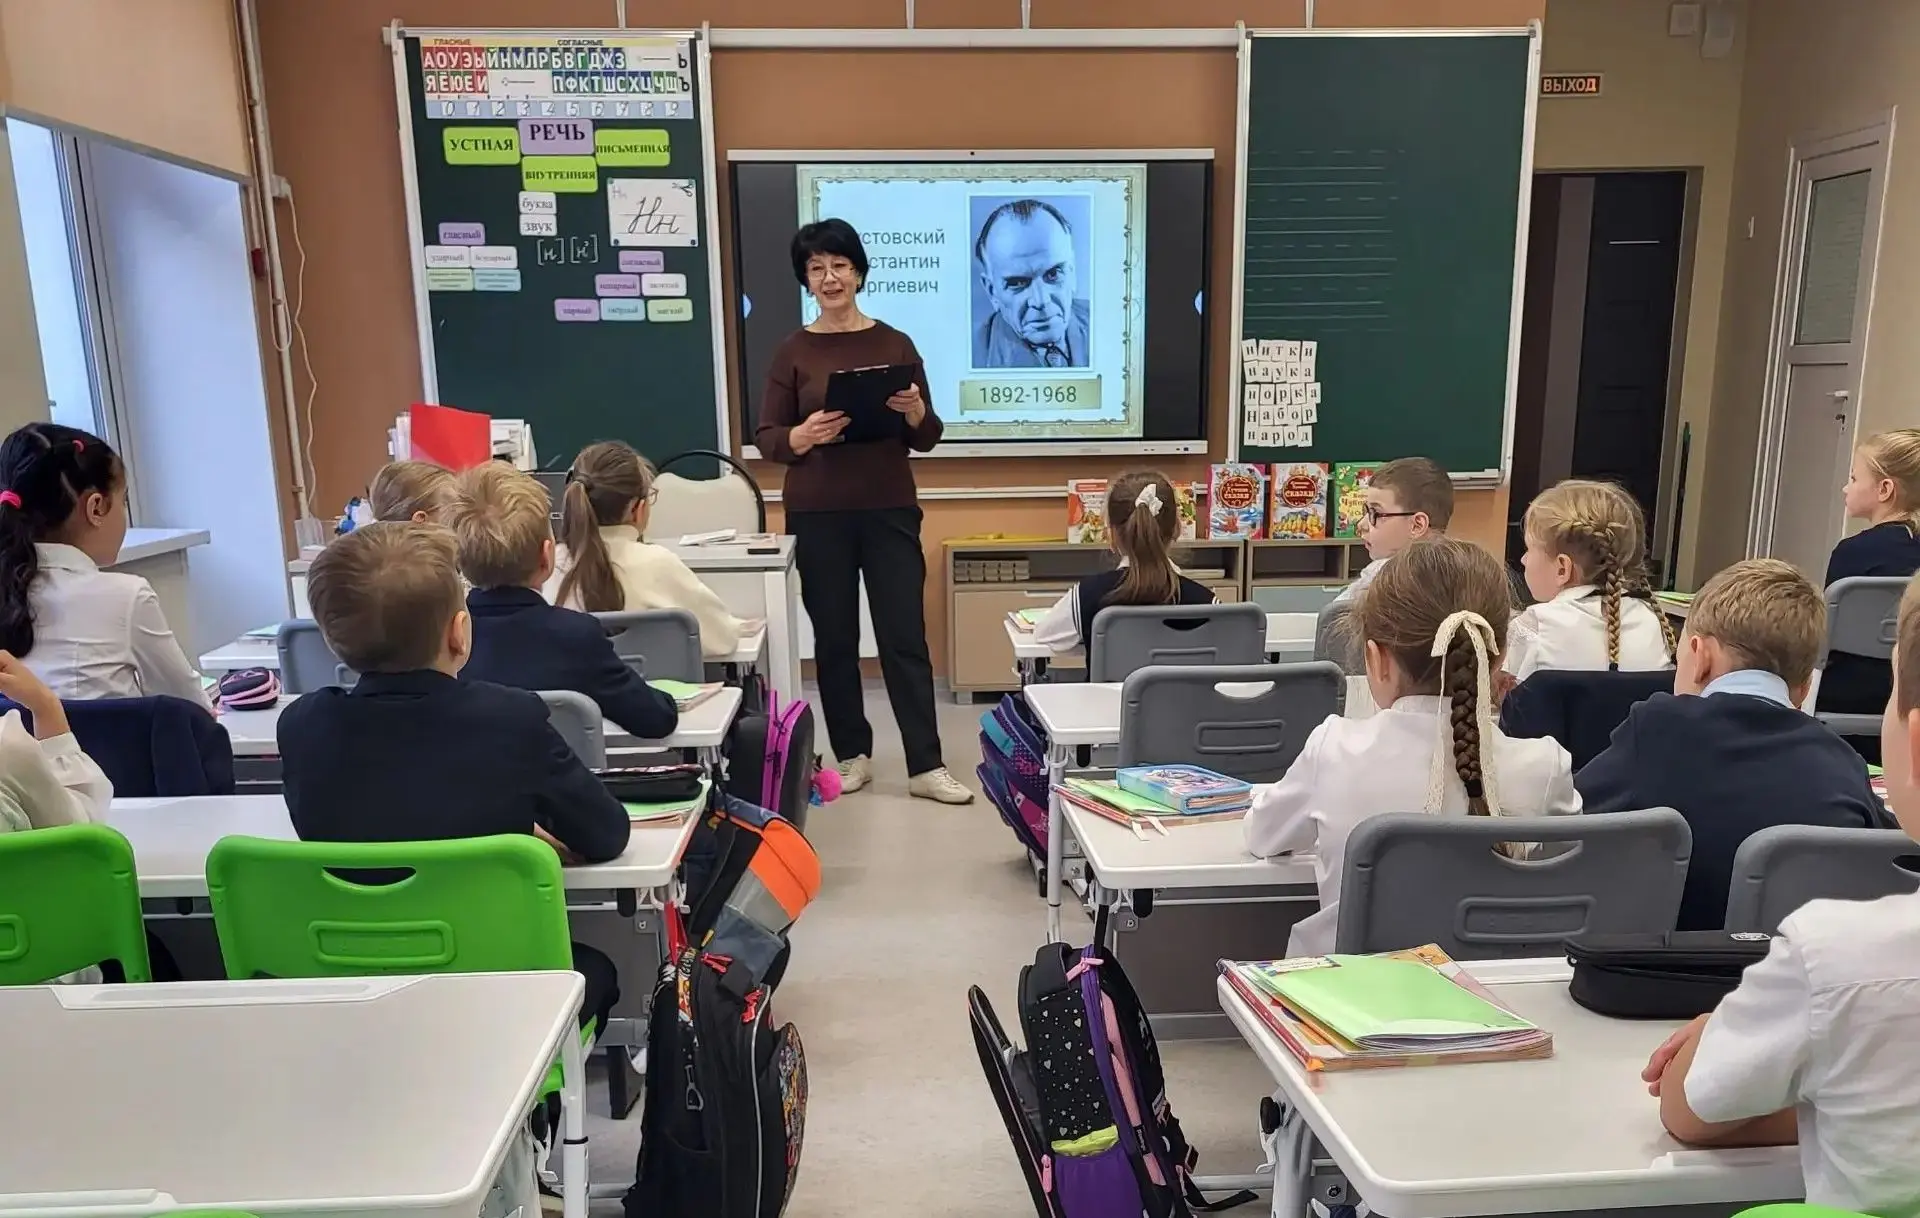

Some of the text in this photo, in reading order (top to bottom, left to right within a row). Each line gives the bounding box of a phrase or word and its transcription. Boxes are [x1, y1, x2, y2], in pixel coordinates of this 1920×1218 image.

[1543, 78, 1597, 92] ВЫХОД
[529, 123, 586, 141] РЕЧЬ
[449, 139, 514, 151] УСТНАЯ
[596, 144, 671, 153] ПИСЬМЕННАЯ
[525, 170, 596, 180] ВНУТРЕННЯЯ
[522, 197, 553, 211] буква
[524, 221, 553, 234] звук
[859, 228, 945, 245] стовский
[869, 256, 940, 269] стантин
[867, 280, 939, 297] ргиевич
[1246, 345, 1313, 357] нитки
[1248, 366, 1311, 380] наука
[980, 386, 1077, 404] 1892-1968
[1248, 388, 1317, 402] норка
[1247, 407, 1313, 422] Набор
[1248, 431, 1309, 445] народ
